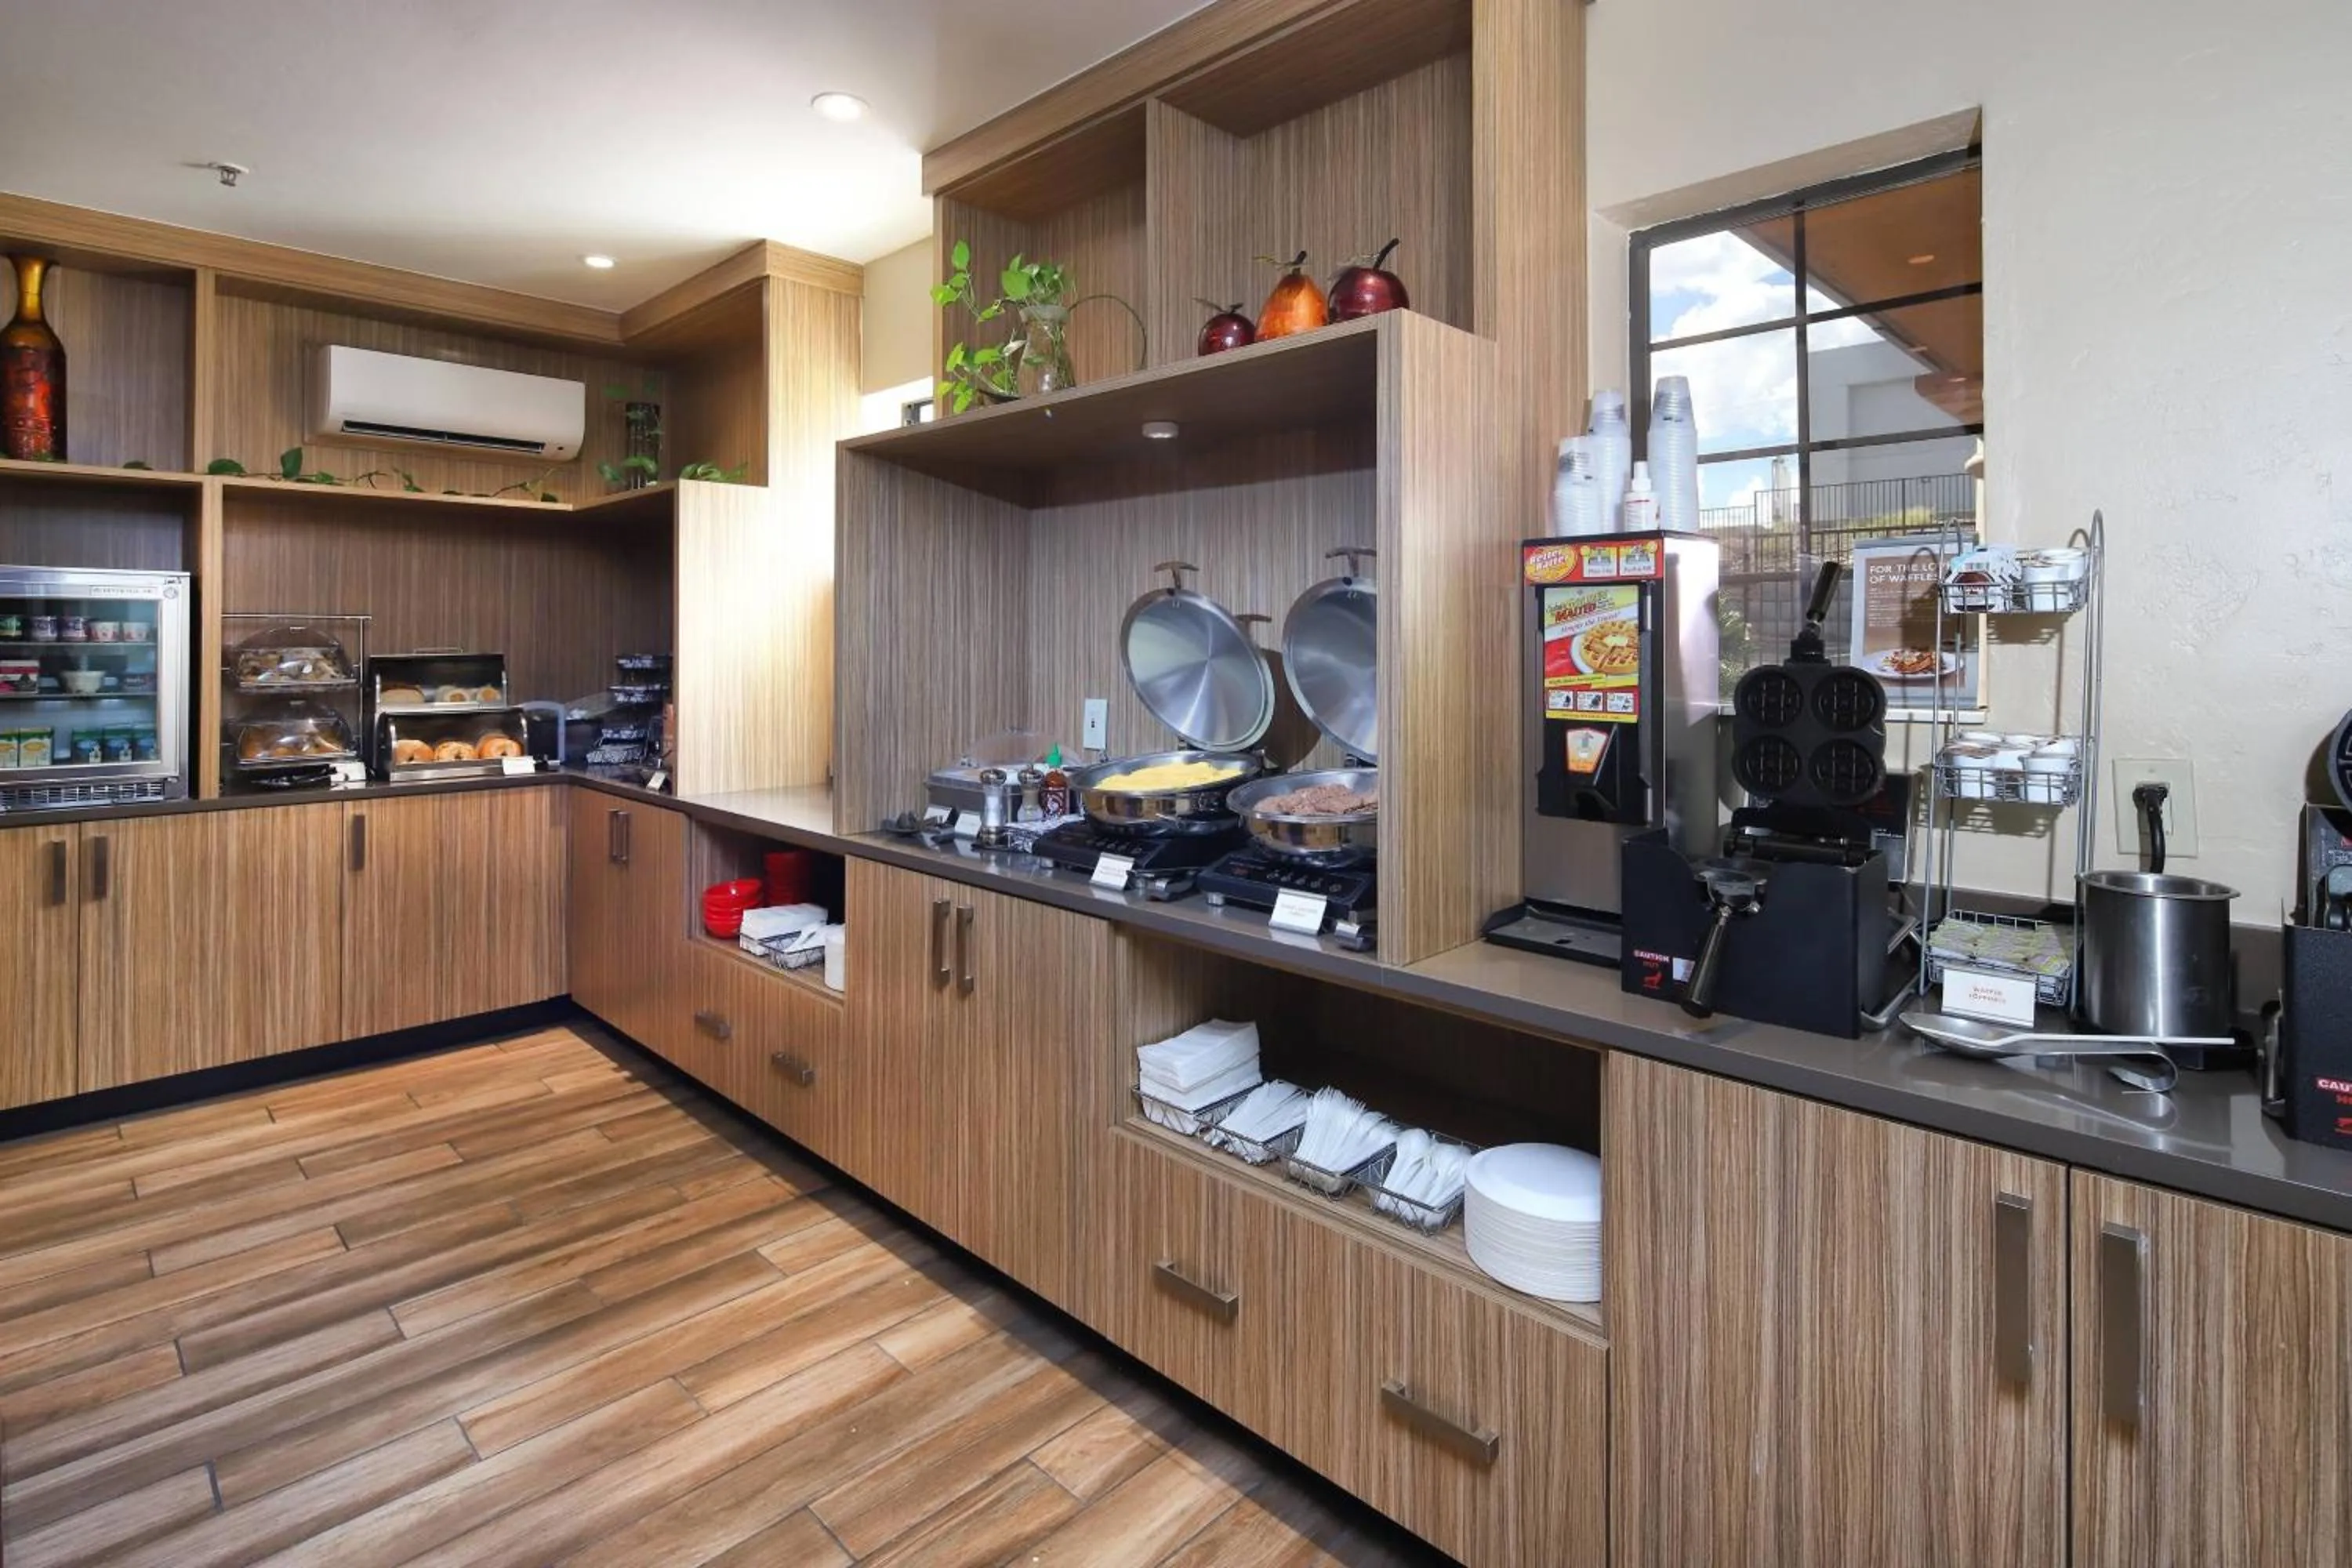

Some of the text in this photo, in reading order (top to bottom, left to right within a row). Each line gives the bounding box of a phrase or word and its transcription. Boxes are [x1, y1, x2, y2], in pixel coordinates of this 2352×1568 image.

[1870, 565, 1892, 574] FOR
[1896, 564, 1918, 572] THE
[1869, 575, 1885, 584] OF
[1634, 949, 1669, 962] CAUTION
[2318, 1078, 2352, 1093] CAU
